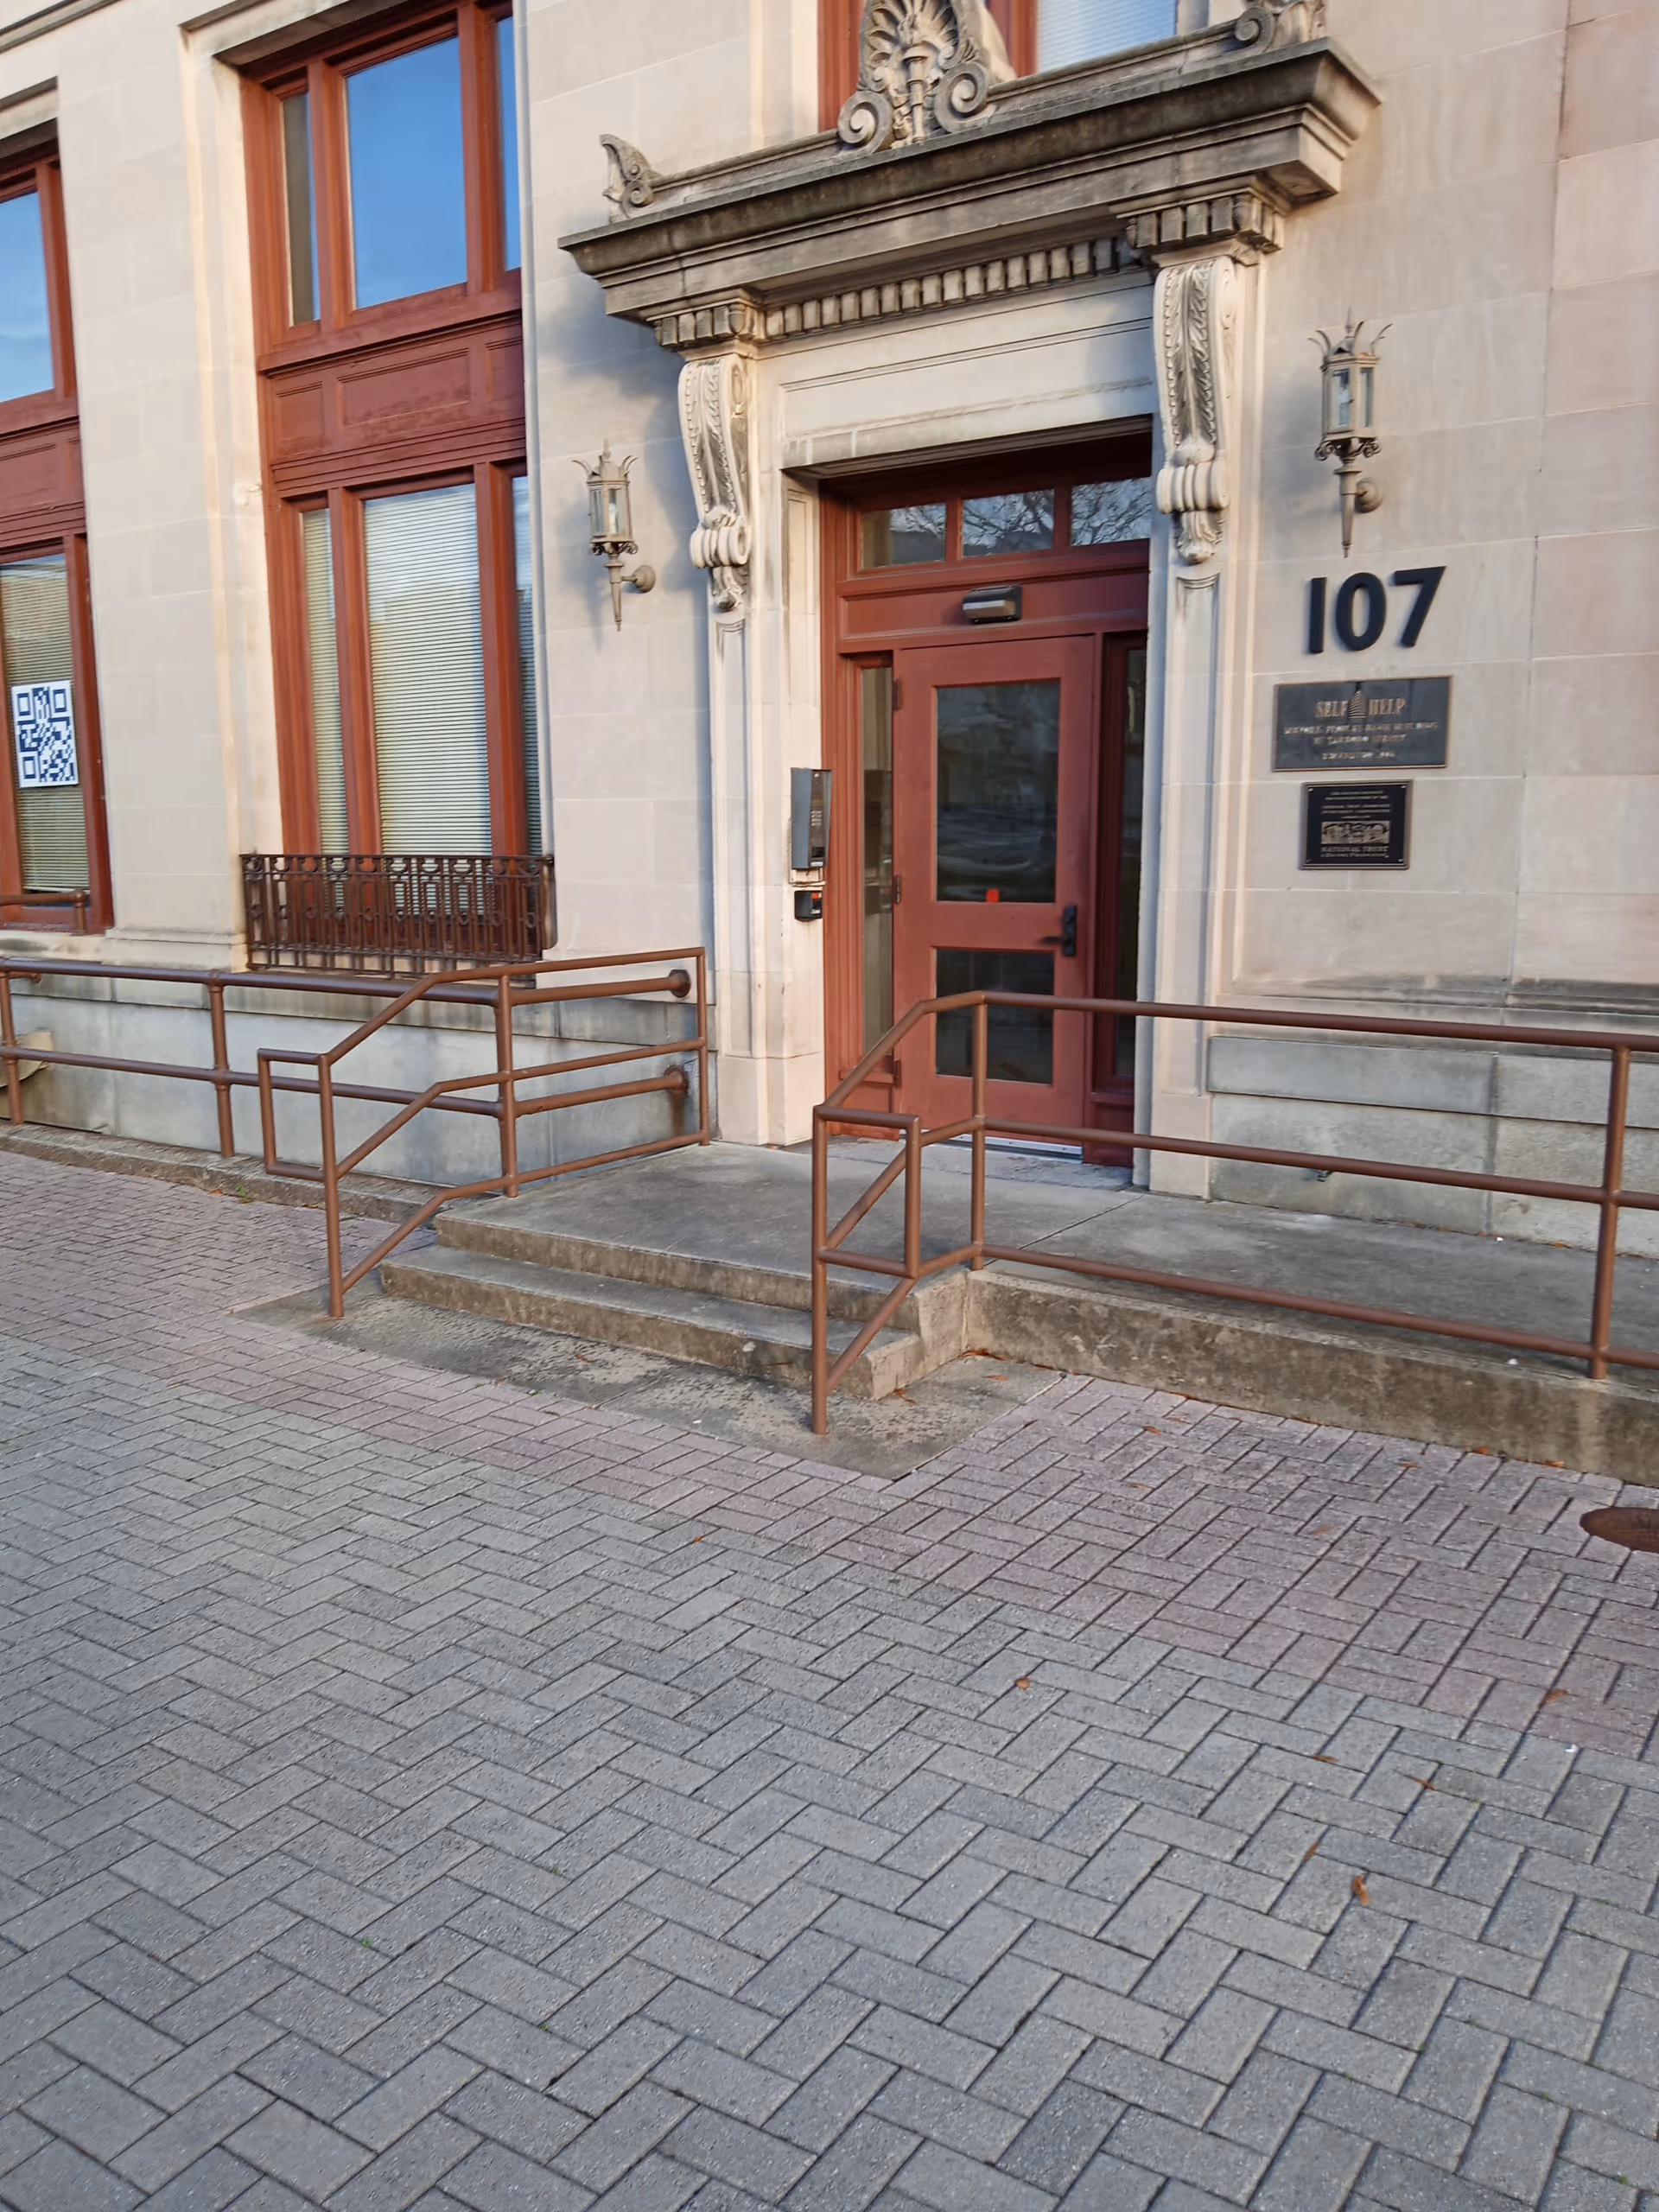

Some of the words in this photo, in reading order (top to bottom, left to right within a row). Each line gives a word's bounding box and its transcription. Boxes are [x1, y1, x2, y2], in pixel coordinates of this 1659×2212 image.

[1308, 566, 1446, 654] 107
[1315, 700, 1348, 718] SELF
[1369, 697, 1406, 715] HELP
